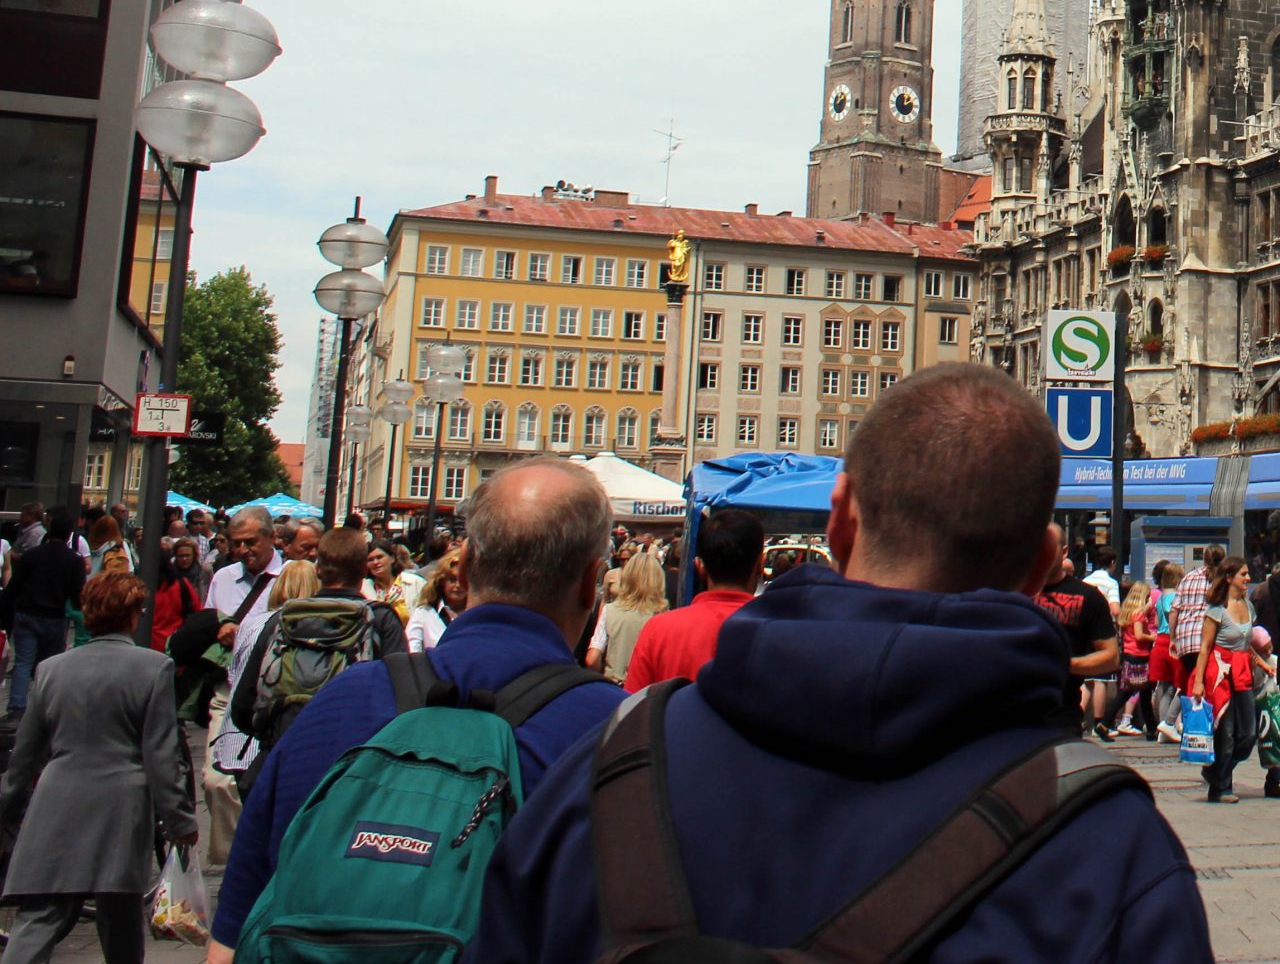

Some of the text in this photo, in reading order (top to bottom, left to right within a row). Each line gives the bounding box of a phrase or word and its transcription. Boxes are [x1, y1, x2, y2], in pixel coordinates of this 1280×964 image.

[1060, 321, 1101, 370] S
[160, 399, 178, 409] 150
[1057, 395, 1101, 451] U
[187, 431, 217, 440] AROVSKI
[1075, 465, 1113, 484] Hybrid-Techn
[1131, 465, 1144, 479] Test
[1144, 462, 1156, 479] bei
[1156, 462, 1168, 479] der
[1169, 462, 1186, 479] MVG
[633, 501, 686, 516] Rischar
[352, 832, 432, 854] JANSPORT
